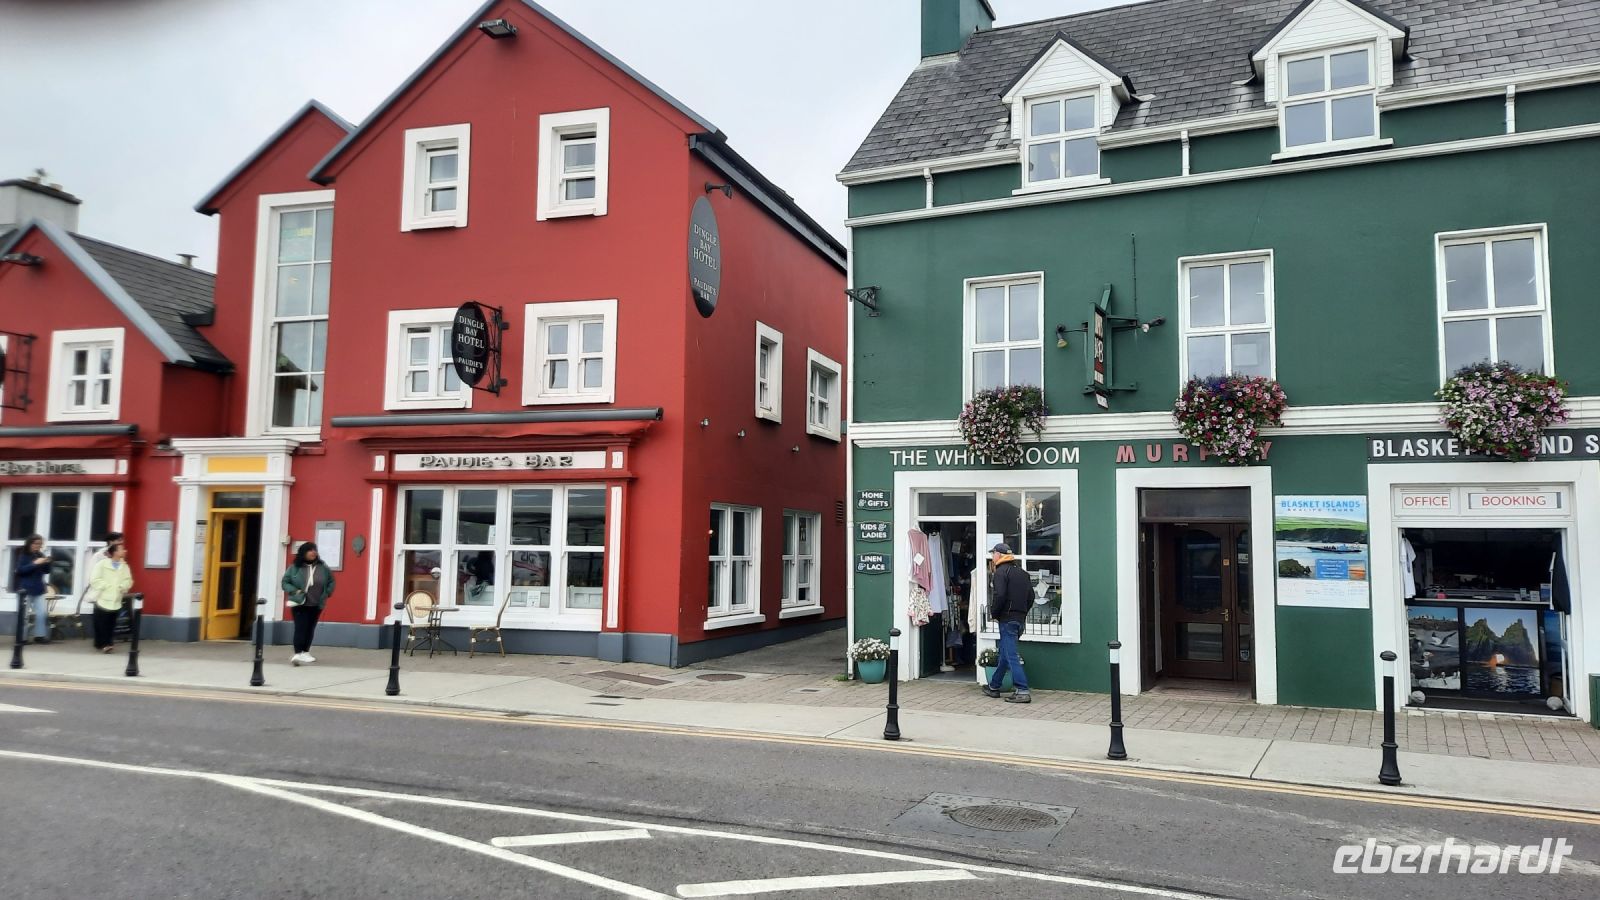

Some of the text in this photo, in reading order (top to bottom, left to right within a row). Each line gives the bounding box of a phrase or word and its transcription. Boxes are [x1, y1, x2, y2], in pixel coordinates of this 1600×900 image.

[694, 223, 717, 246] DINGLE
[700, 239, 711, 253] BAY
[693, 247, 717, 270] HOTEL
[459, 315, 485, 330] DINGLE
[465, 326, 478, 337] BAY
[458, 333, 485, 349] HOTEL
[458, 356, 484, 369] PAUDIE'S
[465, 366, 477, 374] BAR
[889, 450, 928, 466] THE
[1115, 442, 1272, 463] MURPY
[419, 454, 574, 469] PAUDIE'S BAR
[861, 491, 884, 499] HOME
[1481, 495, 1546, 507] BOOKING
[858, 499, 867, 507] &
[1281, 500, 1361, 508] BLASKET ISLANDS
[1403, 496, 1449, 507] OFFICE
[860, 523, 887, 531] KIDS &
[861, 531, 887, 539] LADIES
[857, 563, 866, 571] &
